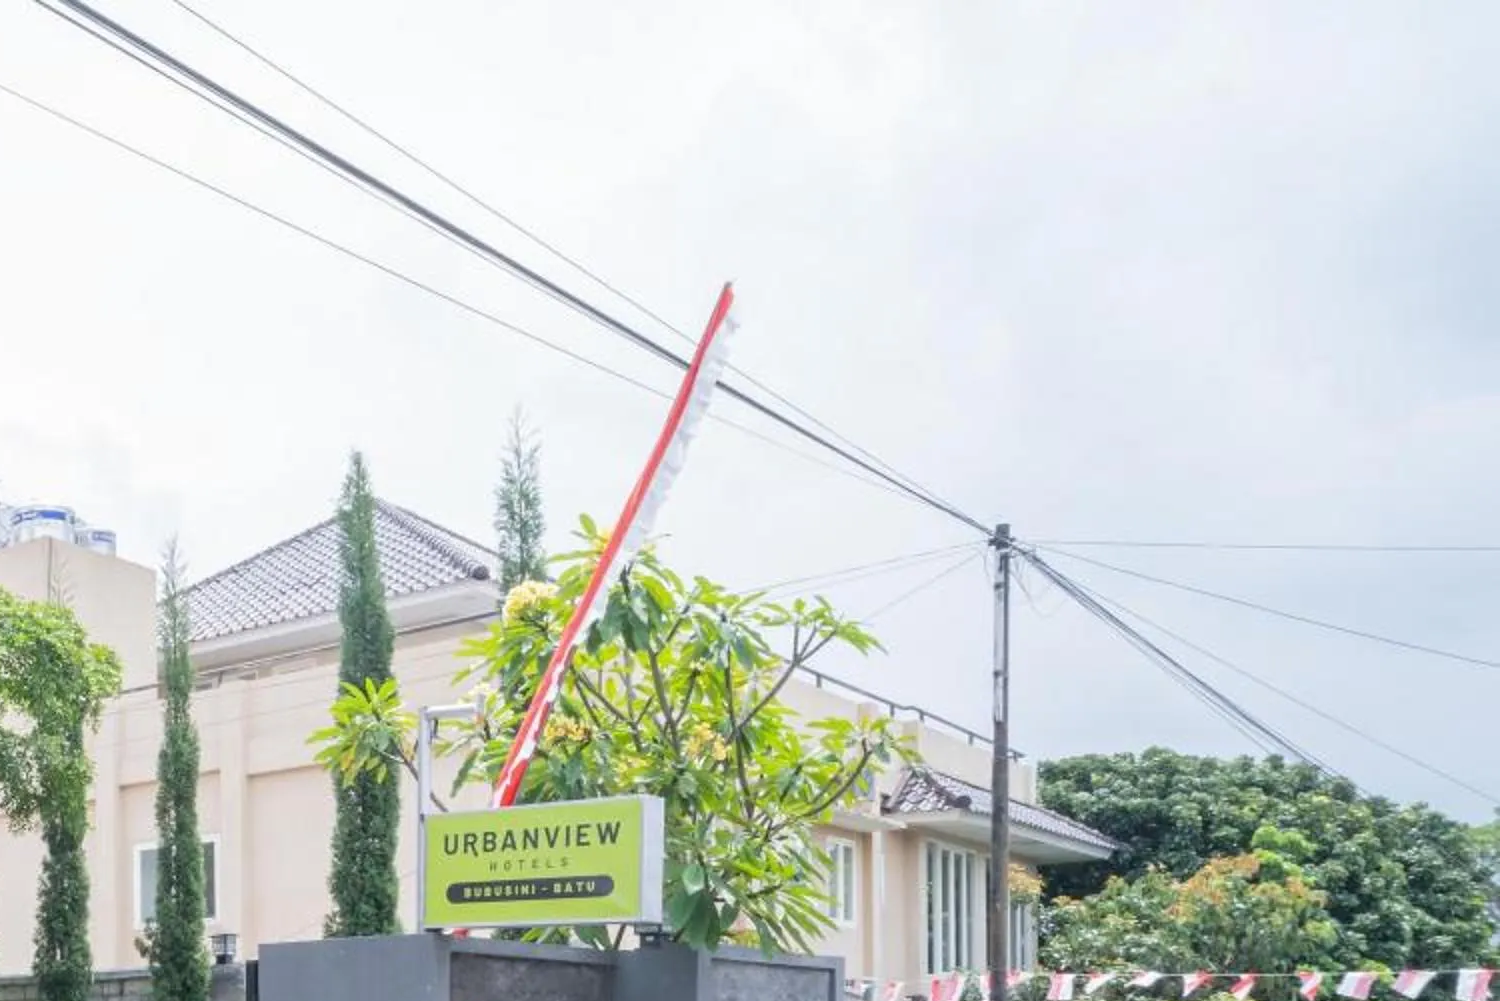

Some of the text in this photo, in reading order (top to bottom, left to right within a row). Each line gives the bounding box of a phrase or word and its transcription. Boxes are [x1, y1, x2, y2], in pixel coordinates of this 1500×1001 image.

[443, 821, 621, 857] URBANVIEW
[489, 857, 570, 872] HOTELS
[553, 880, 596, 894] BATU
